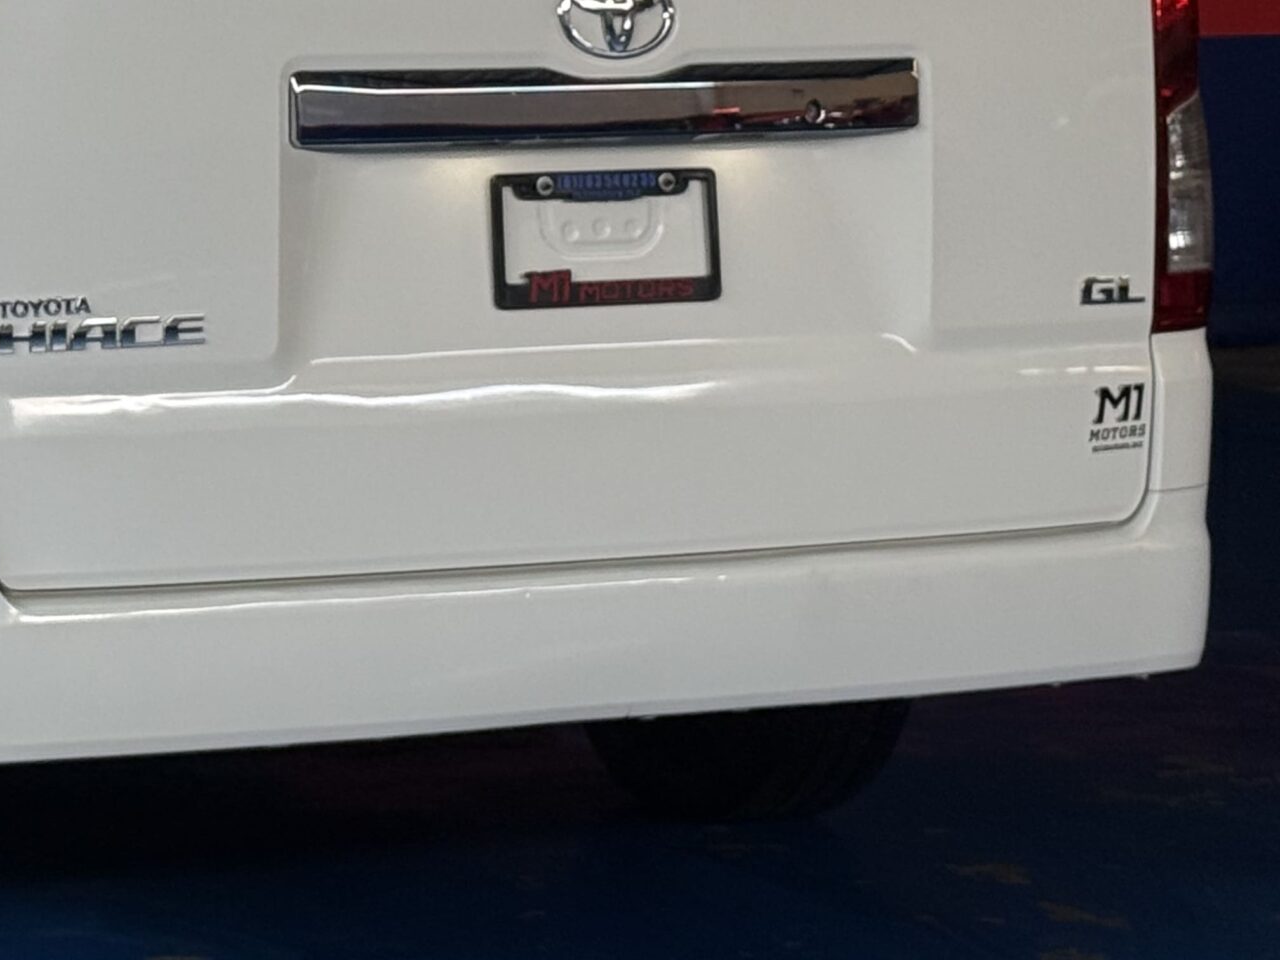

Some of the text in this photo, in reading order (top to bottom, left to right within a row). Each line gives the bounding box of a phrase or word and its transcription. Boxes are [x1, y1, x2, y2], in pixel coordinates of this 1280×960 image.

[521, 270, 695, 305] M1 MOTORS
[1080, 274, 1146, 305] GL
[1092, 383, 1145, 424] M1
[1088, 423, 1147, 442] MOTORS
